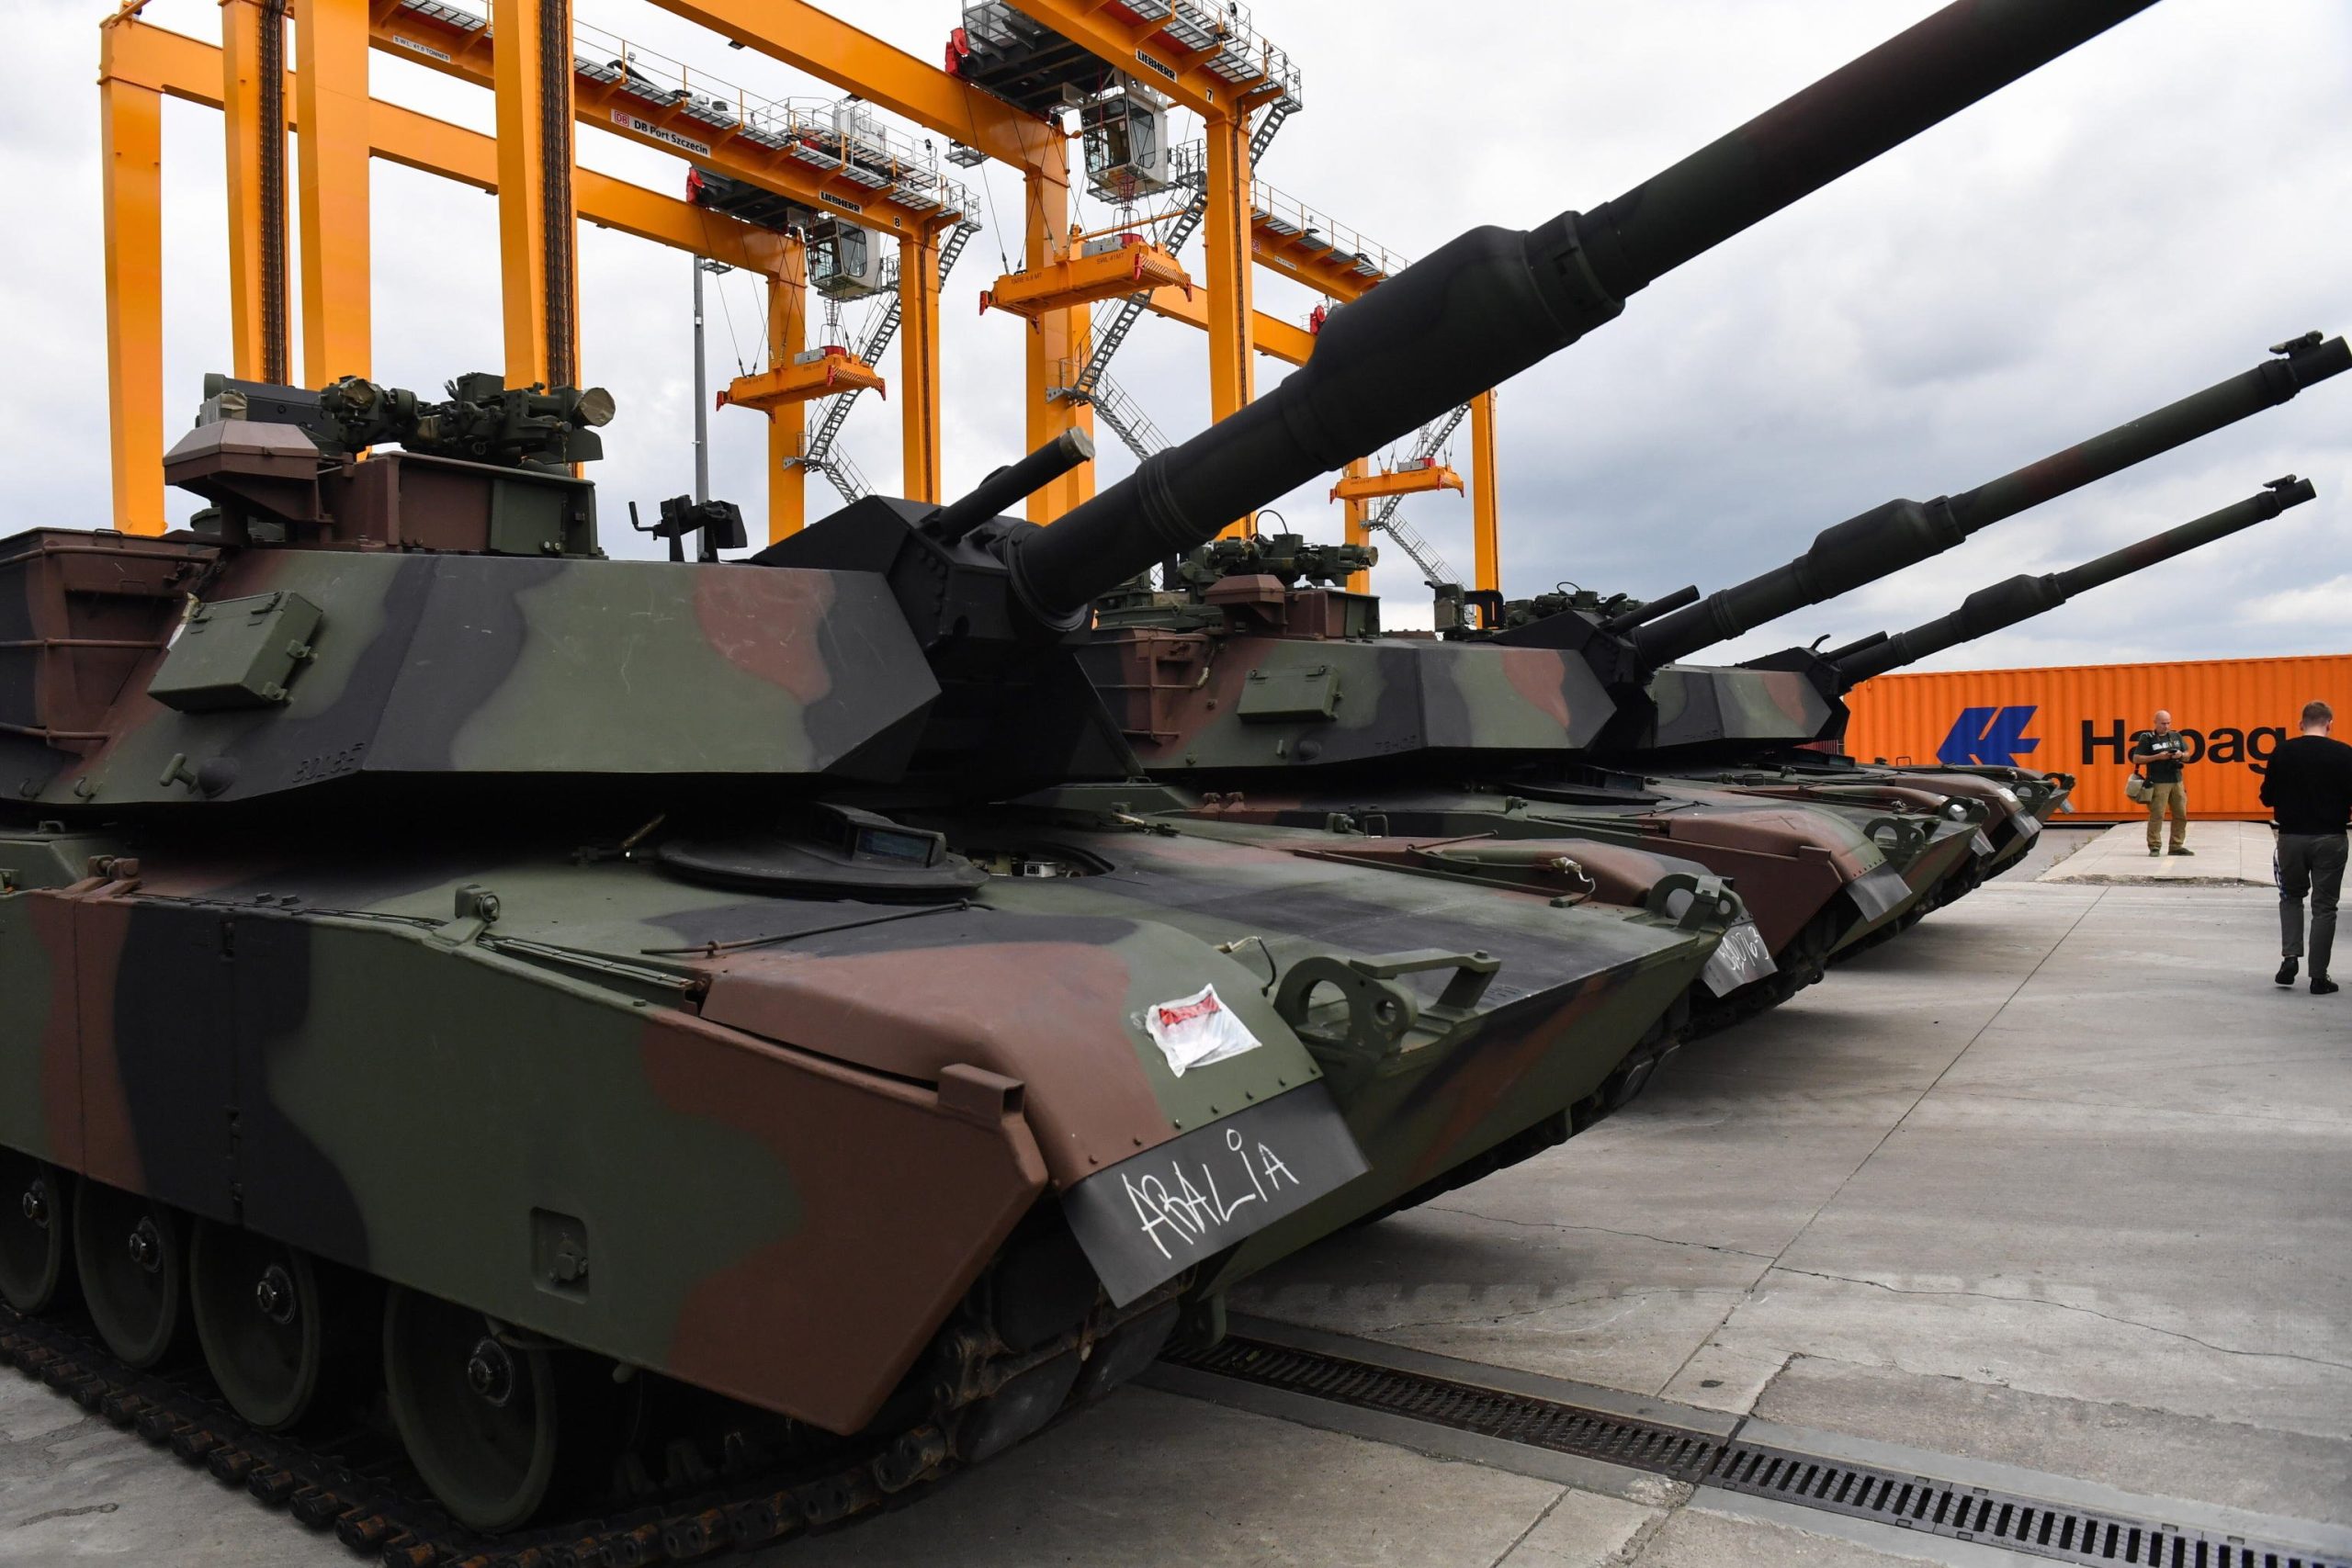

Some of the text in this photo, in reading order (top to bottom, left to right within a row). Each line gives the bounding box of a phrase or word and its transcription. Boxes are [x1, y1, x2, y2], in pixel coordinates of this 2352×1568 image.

[1137, 50, 1175, 80] LIEBHERR
[1207, 88, 1213, 101] 7
[634, 119, 708, 154] DB Port Szczecin
[820, 191, 860, 212] LIEBHERR
[895, 217, 900, 228] 8
